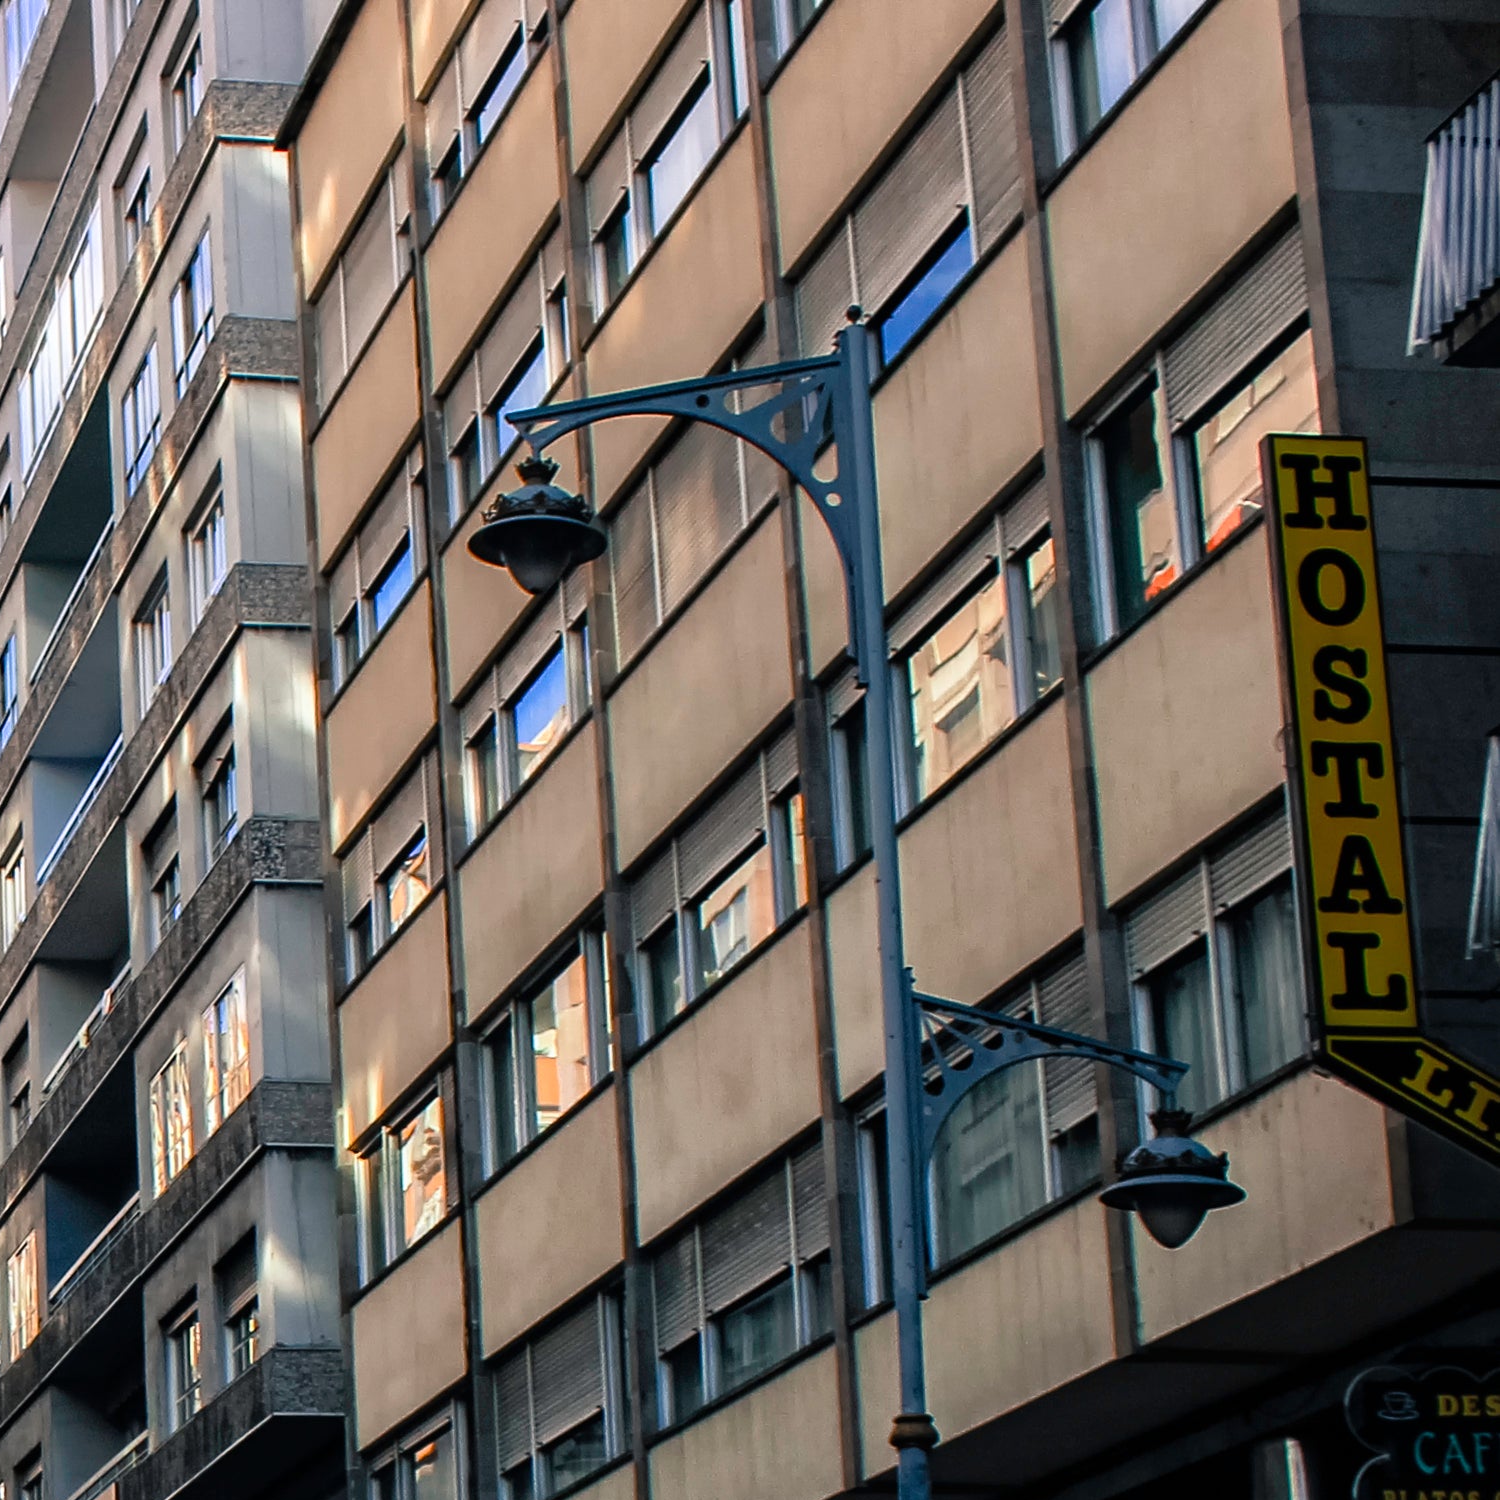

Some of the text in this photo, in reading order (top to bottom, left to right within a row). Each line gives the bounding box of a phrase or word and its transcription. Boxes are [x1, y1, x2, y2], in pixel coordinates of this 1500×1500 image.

[1279, 454, 1409, 1012] HOSTAL
[1401, 1047, 1500, 1150] LI
[1436, 1394, 1500, 1417] DES
[1413, 1431, 1500, 1475] CAF
